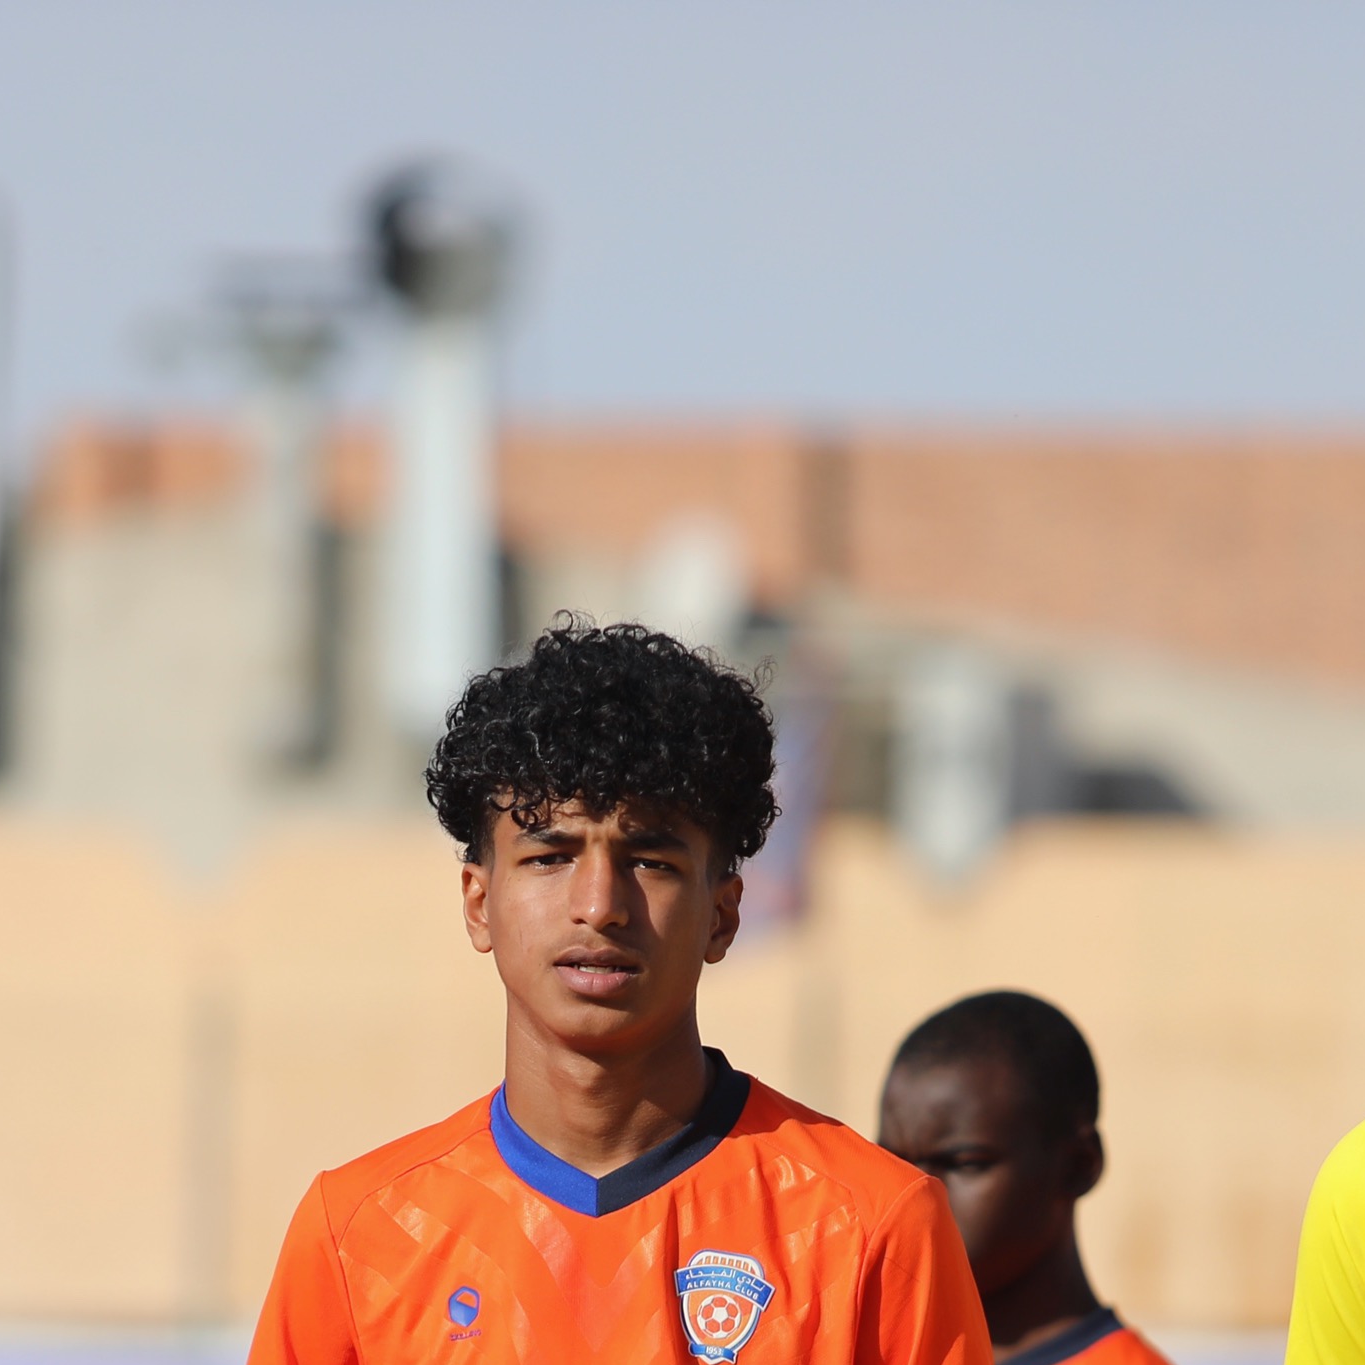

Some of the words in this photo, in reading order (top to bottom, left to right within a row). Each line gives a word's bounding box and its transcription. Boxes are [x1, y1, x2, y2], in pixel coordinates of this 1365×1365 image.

[687, 1280, 731, 1290] ALFAYHA
[735, 1284, 759, 1300] CLUB
[706, 1346, 723, 1356] 1953
